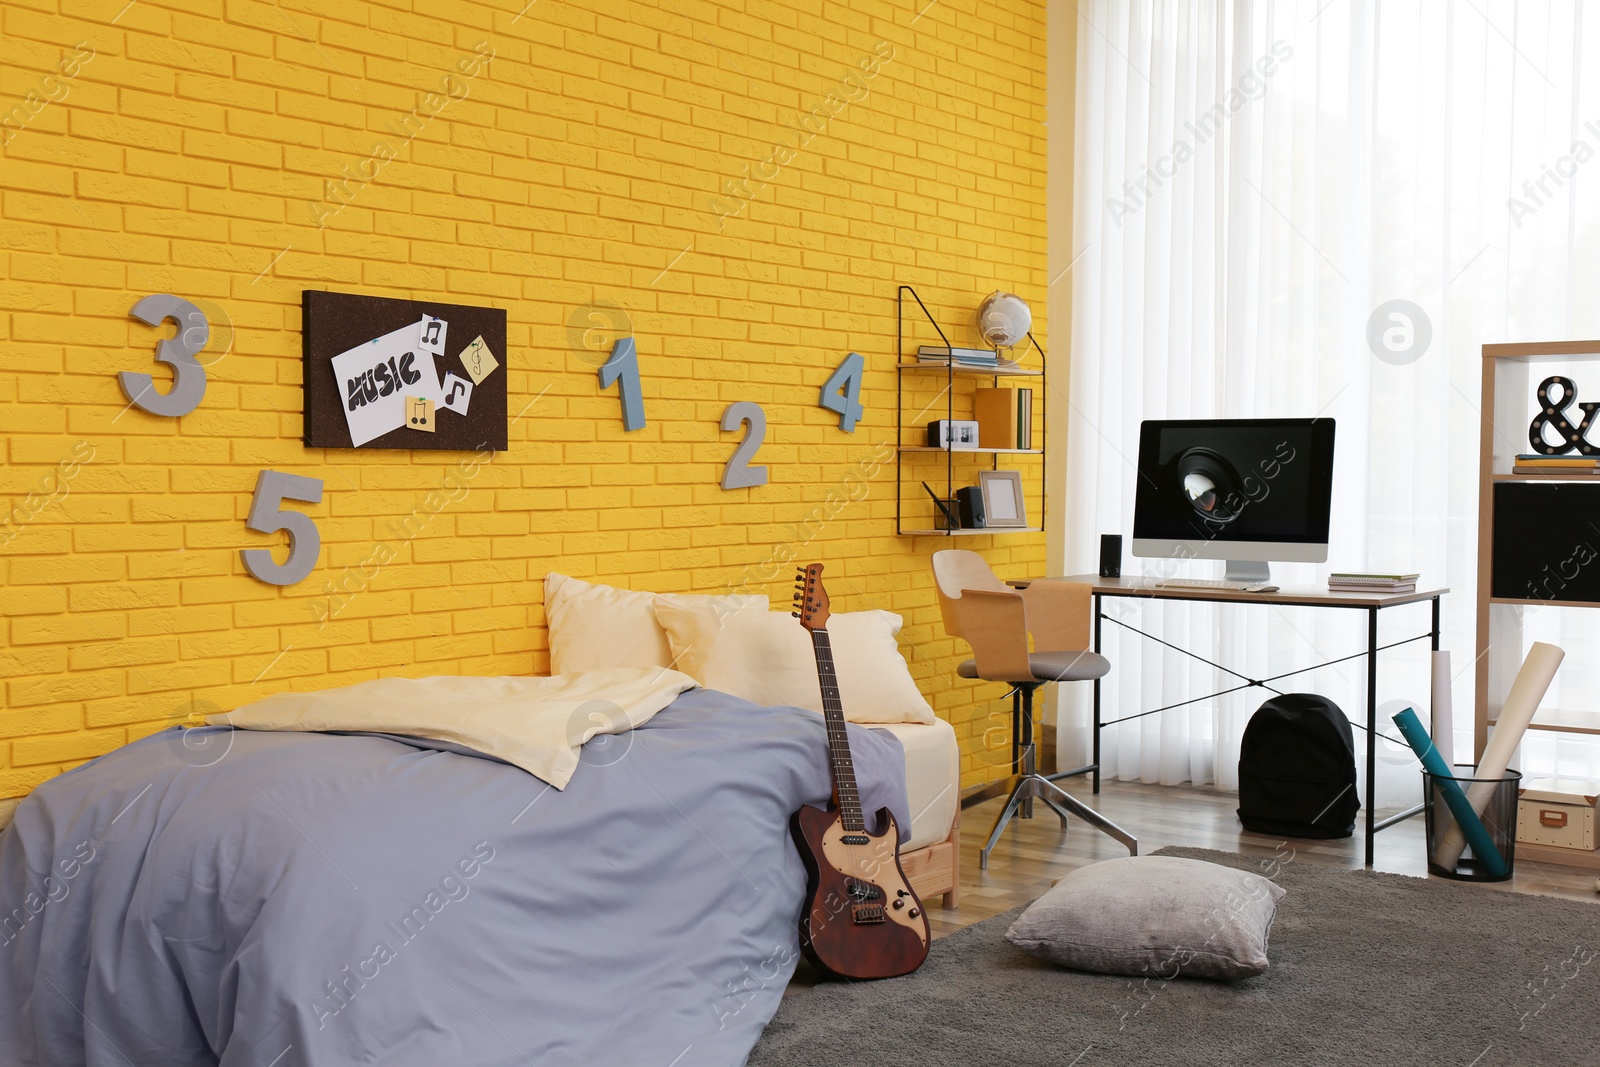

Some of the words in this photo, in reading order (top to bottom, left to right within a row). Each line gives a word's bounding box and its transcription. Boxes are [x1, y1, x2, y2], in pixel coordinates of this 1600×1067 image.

[119, 294, 209, 417] 3
[347, 351, 422, 412] MUSIC
[598, 337, 646, 432] 1
[819, 352, 864, 432] 4
[720, 401, 768, 490] 2
[241, 470, 323, 586] 5
